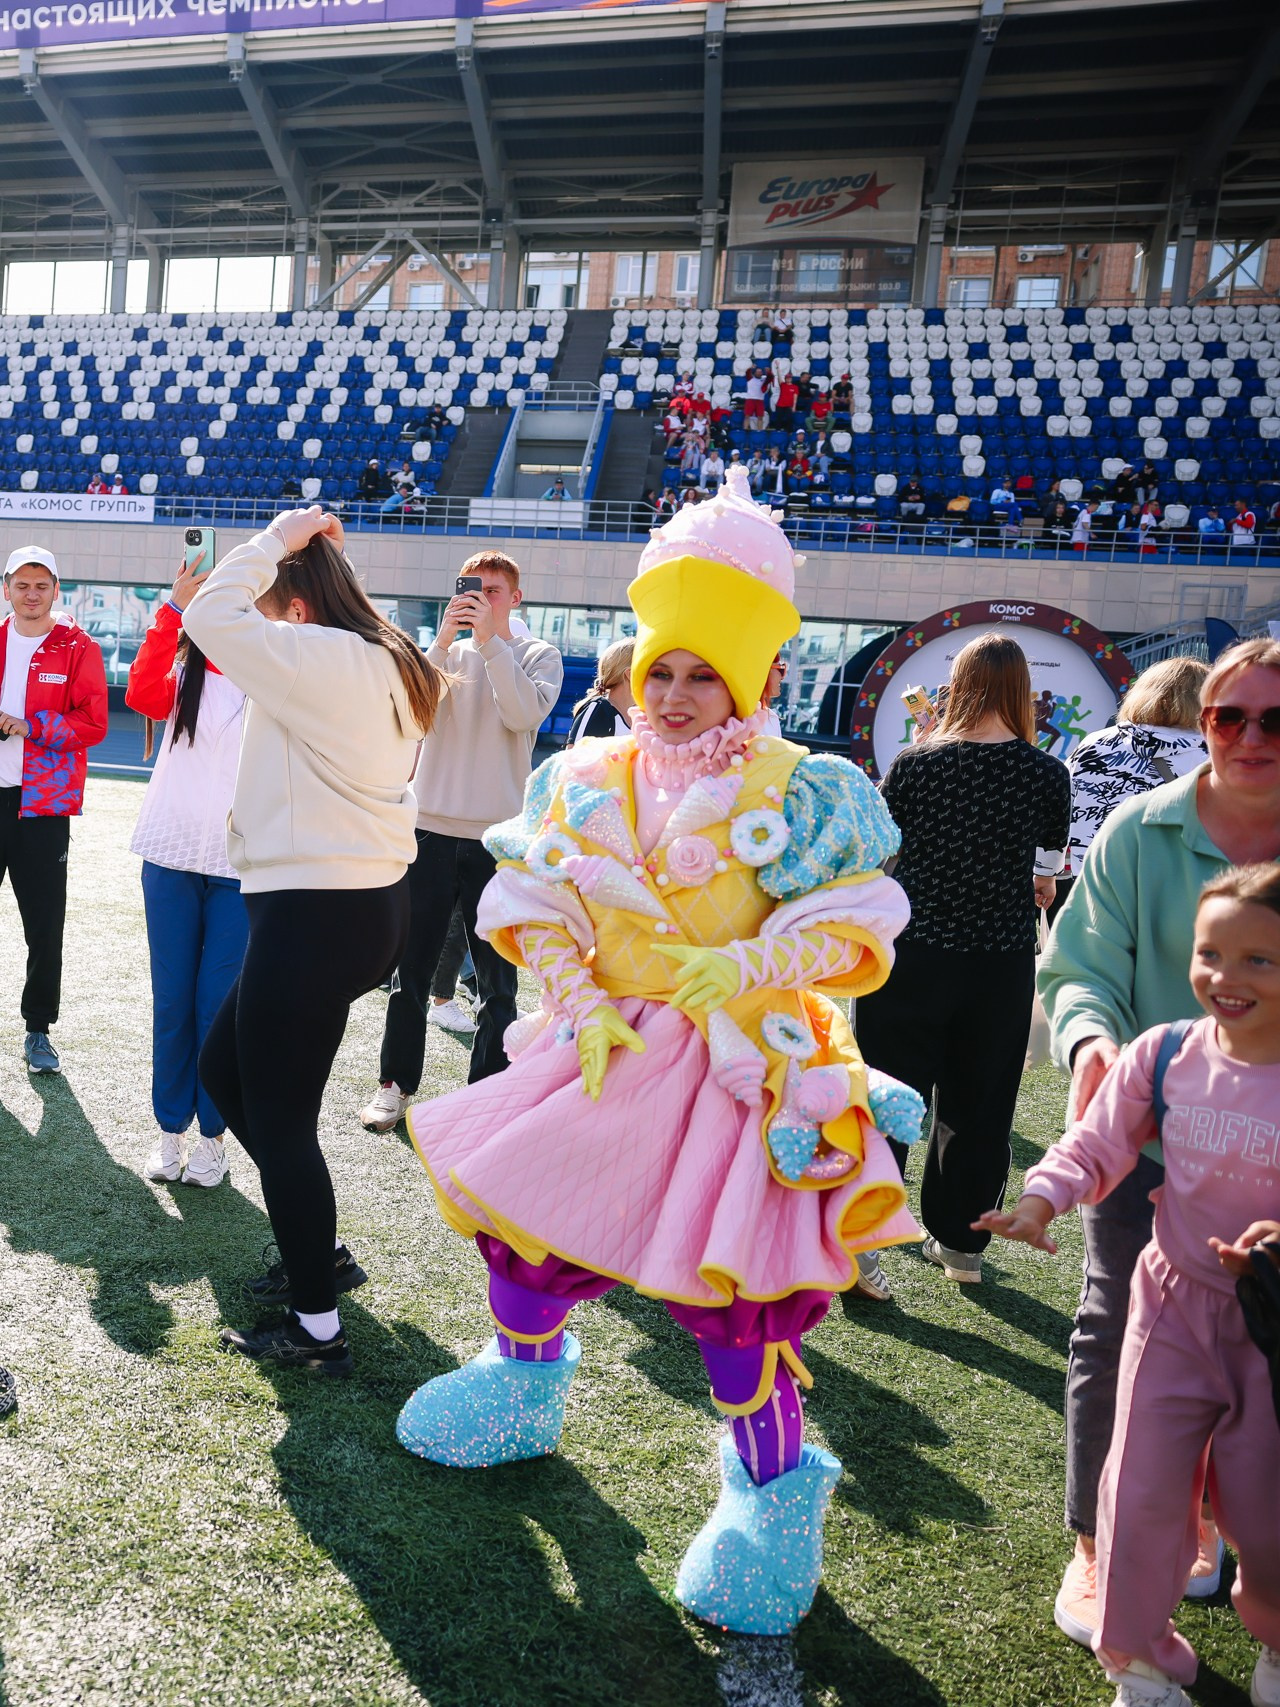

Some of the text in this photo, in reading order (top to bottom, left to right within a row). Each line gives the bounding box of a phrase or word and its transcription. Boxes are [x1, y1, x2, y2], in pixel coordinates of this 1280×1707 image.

[811, 258, 864, 270] РОССИИ
[20, 498, 83, 512] «КОМОС
[90, 500, 146, 513] ГРУПП»
[989, 603, 1036, 616] КОМОС
[1163, 1104, 1280, 1169] ERFE
[1215, 1169, 1245, 1183] WAY
[1256, 1178, 1273, 1187] TO
